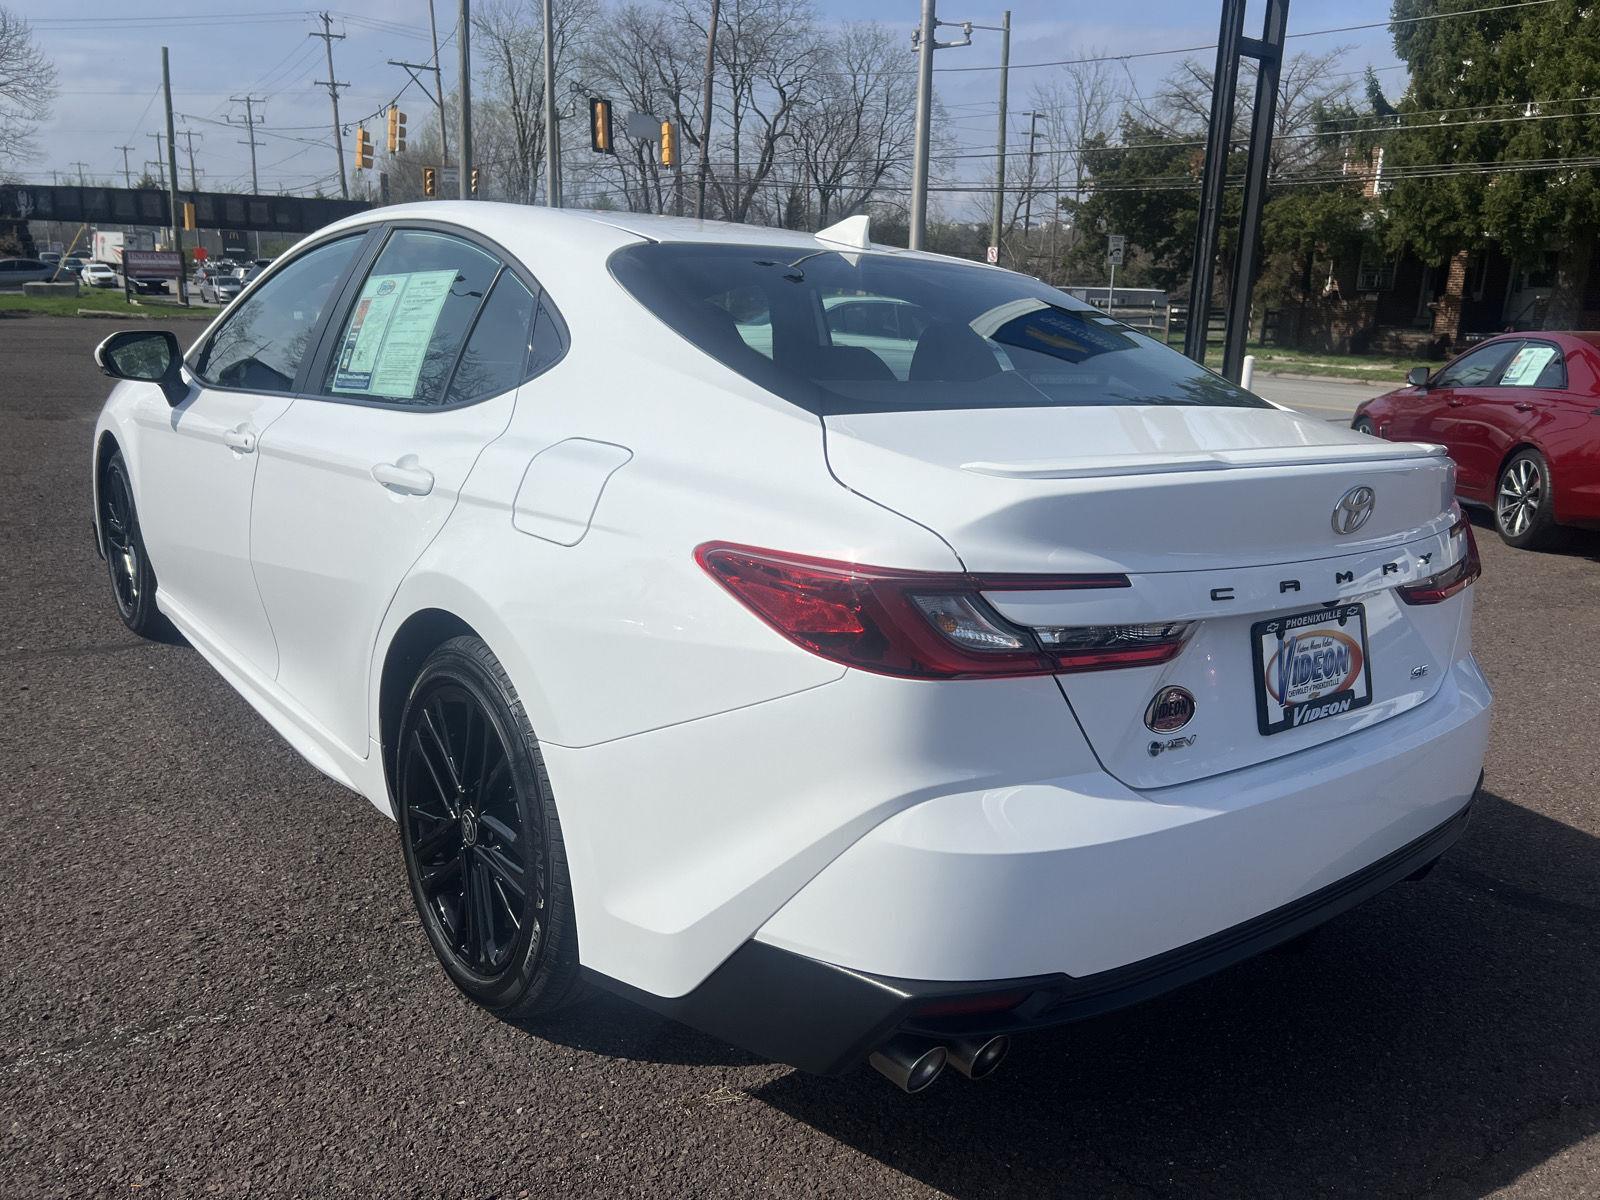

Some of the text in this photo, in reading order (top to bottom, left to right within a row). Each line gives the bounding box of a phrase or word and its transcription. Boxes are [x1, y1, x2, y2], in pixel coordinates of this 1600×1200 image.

[1210, 553, 1432, 601] CAMRY
[1286, 609, 1341, 628] PHOENIXVILLE
[1277, 636, 1350, 707] VIDEON
[1293, 699, 1351, 726] VIDEON
